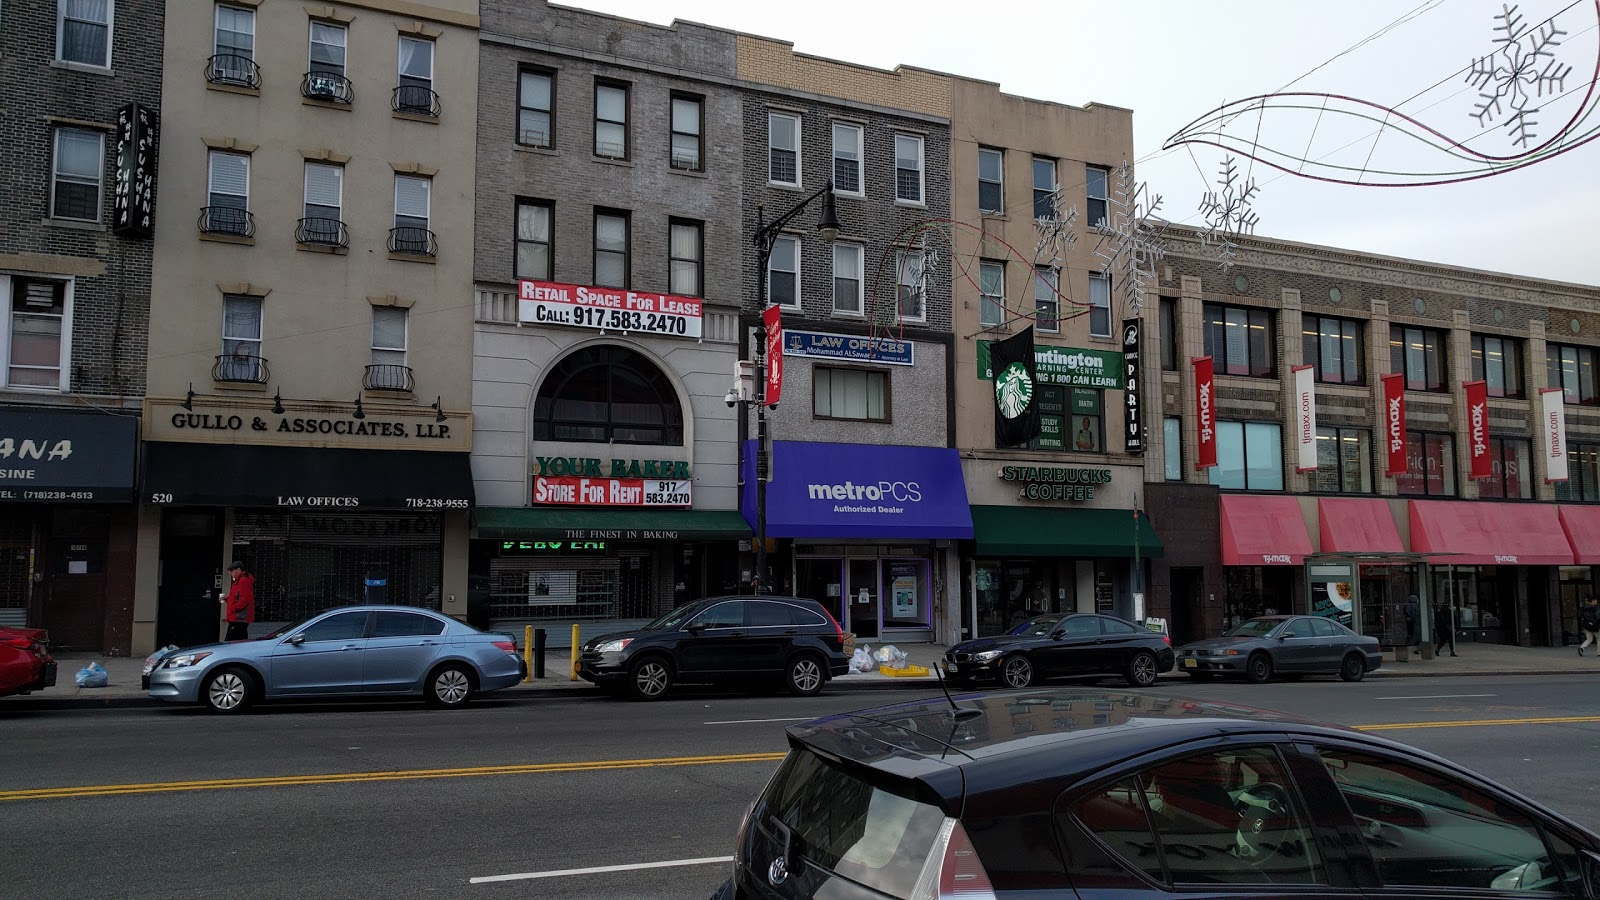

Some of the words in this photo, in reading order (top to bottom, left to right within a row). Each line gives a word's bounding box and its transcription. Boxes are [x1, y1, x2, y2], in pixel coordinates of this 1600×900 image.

[135, 139, 146, 206] SUSHI
[141, 174, 152, 228] HANA
[120, 169, 130, 225] HANA
[573, 307, 687, 335] 917.583.2470
[811, 336, 844, 348] LAW
[849, 340, 905, 353] OFFICES
[806, 346, 843, 357] Mohammad
[1034, 350, 1103, 369] ntington
[1037, 364, 1067, 373] ARNING
[1051, 374, 1055, 383] 1
[1056, 375, 1071, 384] 800
[1072, 376, 1089, 385] CAN
[1091, 377, 1117, 387] LEARN
[1127, 364, 1138, 435] PARTY
[1041, 418, 1058, 426] STUDY
[1302, 391, 1312, 444] tjmaxx.com
[171, 413, 242, 431] GULLO
[251, 417, 267, 431] &
[277, 417, 409, 438] ASSOCIATES,
[416, 424, 451, 439] LLP.
[1041, 425, 1059, 433] SKILLS
[1550, 411, 1562, 459] tjmaxx.com
[1040, 439, 1061, 447] WRITING
[535, 457, 602, 476] YOUR
[610, 458, 690, 479] BAKER
[1003, 465, 1112, 483] STARBUCKS
[659, 481, 677, 492] 917
[808, 481, 922, 502] metroPCS
[1025, 484, 1095, 501] COFFEE
[24, 490, 93, 500] (718)238-4513
[152, 493, 173, 504] 520
[278, 496, 304, 506] LAW
[307, 496, 359, 507] OFFICES
[645, 493, 690, 504] 583.2470
[406, 498, 469, 509] 718-238-9555
[834, 505, 877, 514] Authorized
[878, 505, 904, 514] Dealer
[565, 529, 585, 539] THE
[590, 529, 622, 539] FINEST
[626, 530, 637, 539] IN
[643, 530, 678, 540] BAKING
